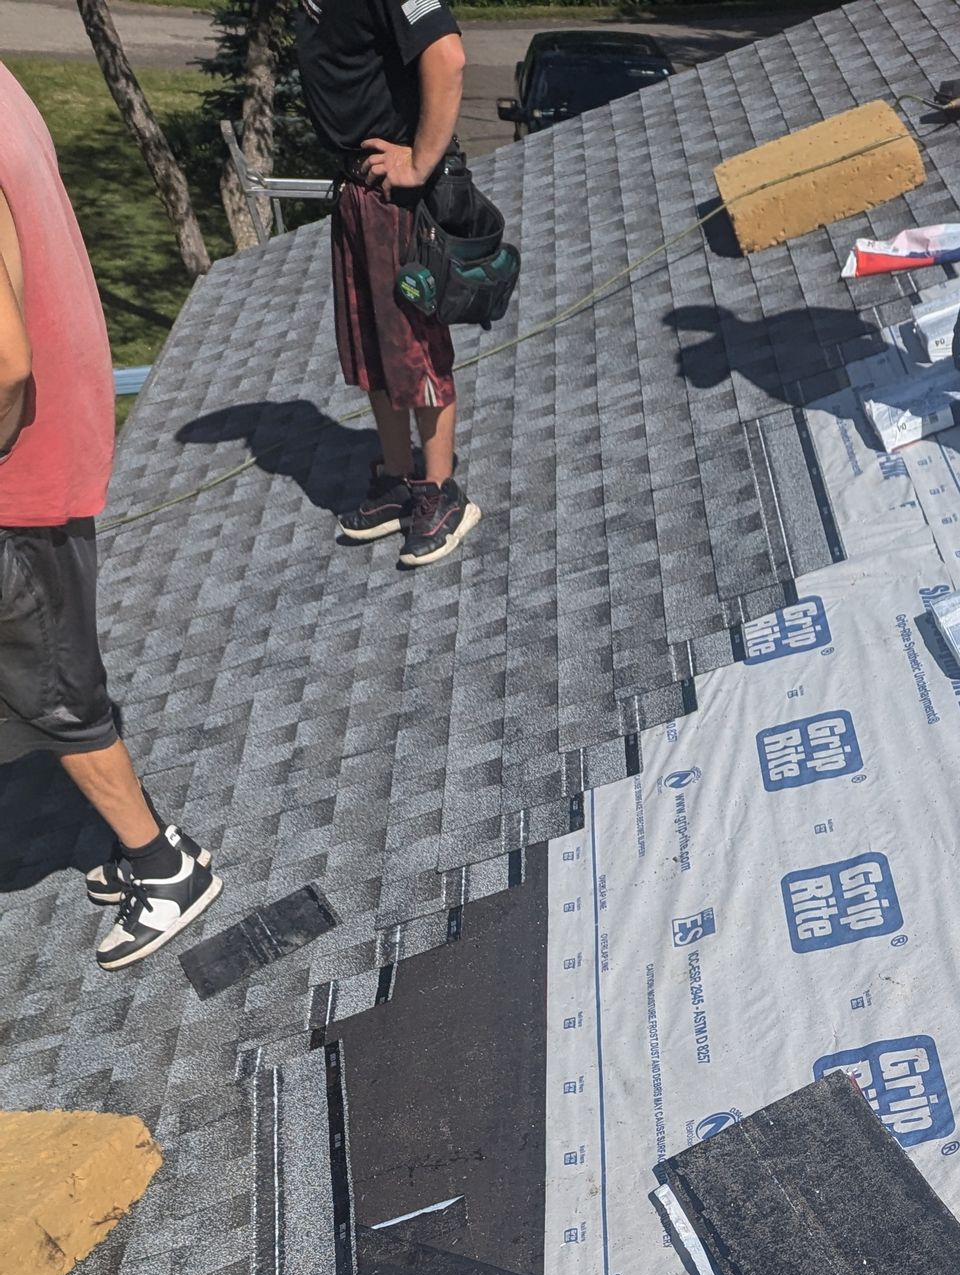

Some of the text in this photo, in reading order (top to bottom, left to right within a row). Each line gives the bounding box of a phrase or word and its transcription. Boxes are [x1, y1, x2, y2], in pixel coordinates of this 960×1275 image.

[782, 601, 823, 648] Grip
[764, 728, 802, 783] Rite
[806, 717, 851, 772] Grip
[788, 874, 831, 941] Rite
[838, 861, 889, 931] Grip
[672, 916, 704, 947] ES
[688, 950, 702, 985] ICC-ESR
[690, 984, 704, 1005] 2945
[693, 1011, 707, 1036] ASTM
[696, 1035, 708, 1044] D
[879, 1047, 938, 1134] Grip
